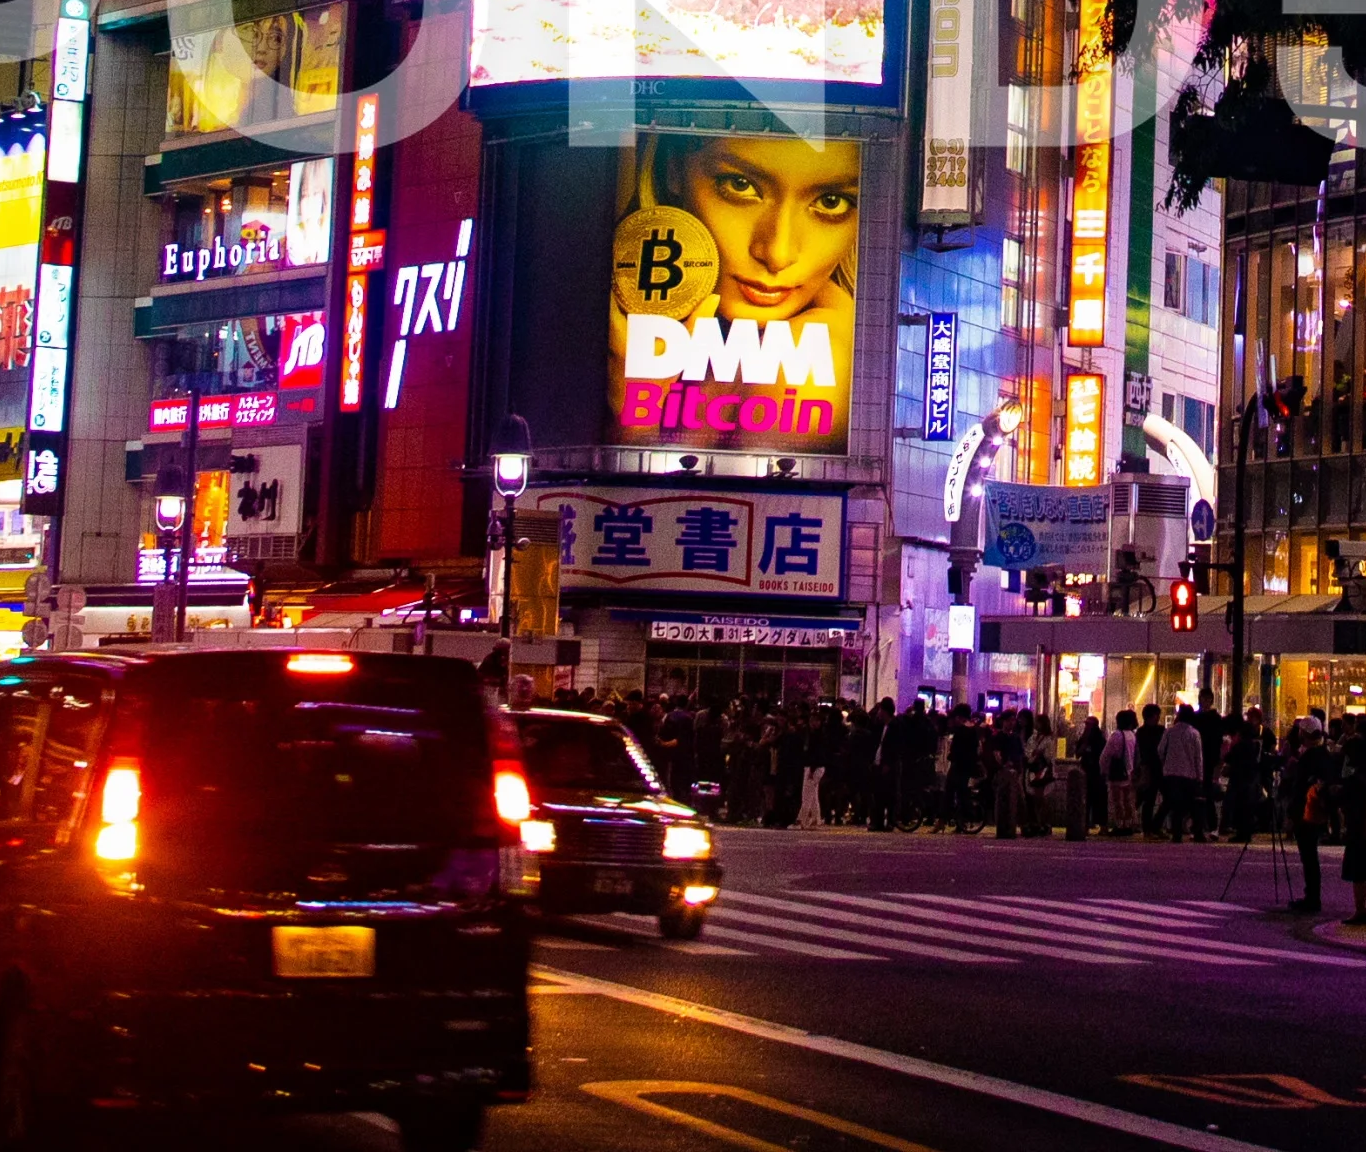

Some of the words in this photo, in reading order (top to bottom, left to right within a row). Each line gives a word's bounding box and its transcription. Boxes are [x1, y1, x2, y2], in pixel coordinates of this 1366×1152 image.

[629, 81, 667, 96] DHC
[164, 236, 280, 280] Euphoria
[1074, 209, 1105, 330] 三千
[283, 323, 326, 376] JTB
[624, 313, 836, 387] DMM
[930, 320, 952, 435] 大盛堂商事ビル
[620, 381, 833, 436] Bitcoin
[759, 579, 789, 592] BOOKS
[793, 580, 835, 594] TAISEIDO
[702, 615, 770, 626] TAISEIDO
